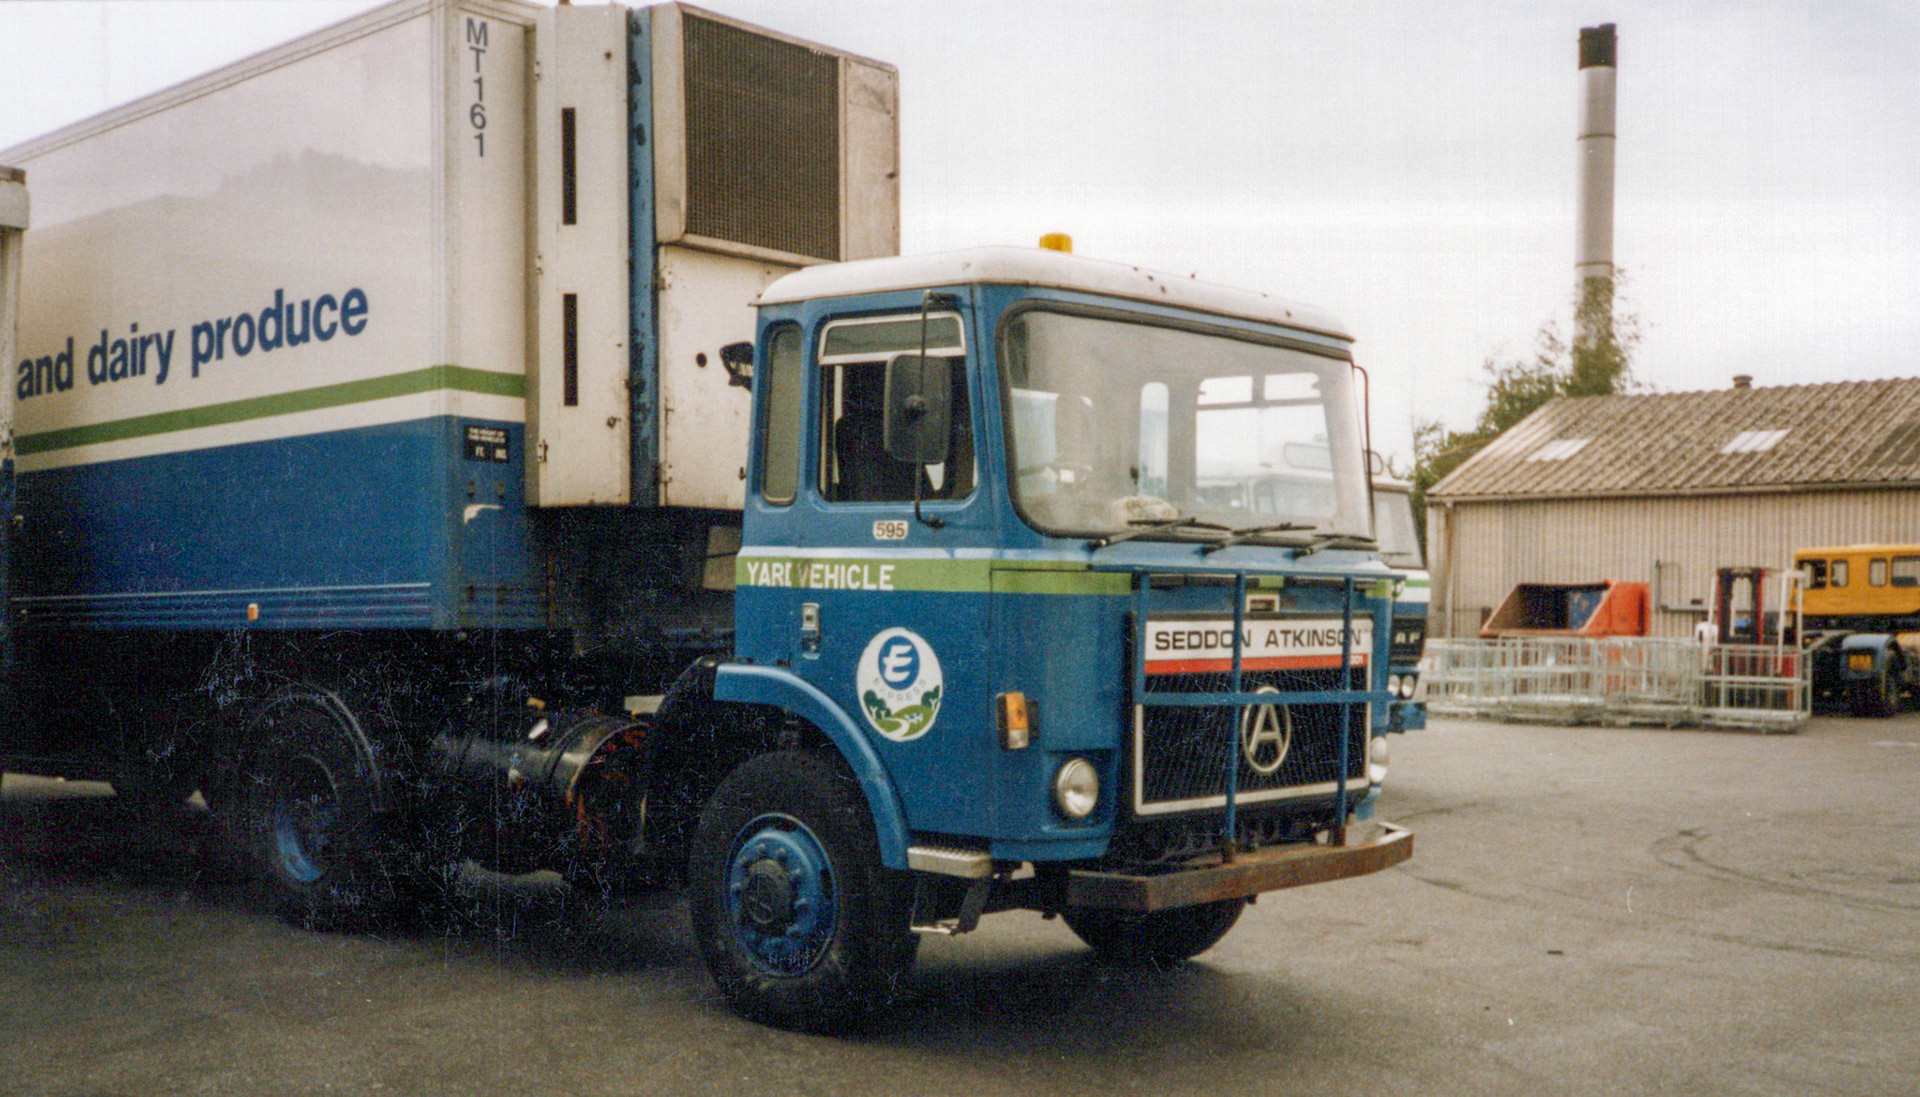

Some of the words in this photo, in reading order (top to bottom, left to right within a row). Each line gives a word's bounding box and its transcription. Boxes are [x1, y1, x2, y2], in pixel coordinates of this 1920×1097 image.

[466, 17, 488, 158] MT161
[16, 336, 74, 400] and
[87, 322, 176, 386] dairy
[191, 287, 369, 378] produce
[876, 521, 905, 538] 595
[797, 563, 895, 591] VEHICLE
[1155, 629, 1251, 651] SEDDON
[1264, 628, 1361, 648] ATKINSON
[1395, 632, 1420, 644] AF
